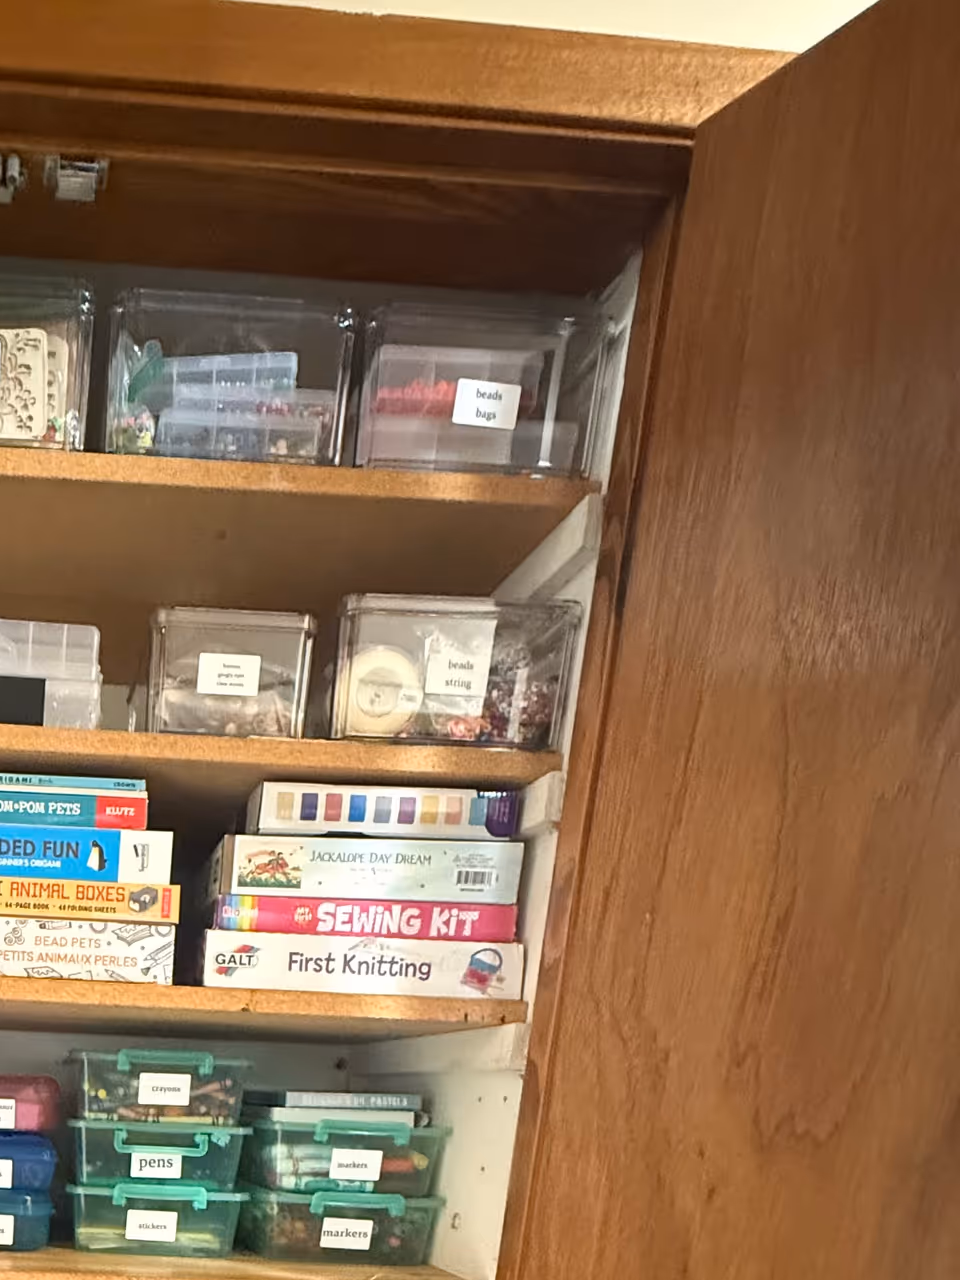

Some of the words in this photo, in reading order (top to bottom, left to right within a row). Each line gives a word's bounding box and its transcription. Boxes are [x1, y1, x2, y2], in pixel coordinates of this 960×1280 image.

[476, 387, 503, 401] beads
[475, 407, 497, 421] bags
[448, 659, 474, 670] beads
[444, 677, 472, 690] string
[48, 802, 81, 815] PETS
[105, 806, 136, 816] KLUTZ
[42, 840, 79, 859] FUN
[30, 859, 61, 868] ORIGAMI
[310, 850, 365, 864] JACKALOPE
[369, 852, 392, 864] DAY
[395, 853, 432, 865] DREAM
[9, 881, 70, 900] ANIMAL
[76, 884, 126, 903] BOXES
[32, 903, 50, 911] BOOK
[67, 905, 93, 913] FOLDING
[94, 906, 117, 914] SHEETS
[33, 935, 67, 948] BEAD
[71, 937, 102, 949] PETS
[35, 951, 91, 965] ANIMAUX
[93, 954, 138, 968] PERLES
[214, 953, 254, 967] GALT
[288, 951, 336, 974] First
[342, 953, 432, 981] Knitting
[151, 1085, 181, 1093] crayons
[139, 1157, 174, 1171] pens
[337, 1161, 368, 1169] markers
[138, 1223, 167, 1231] stickers
[323, 1227, 369, 1239] markers
